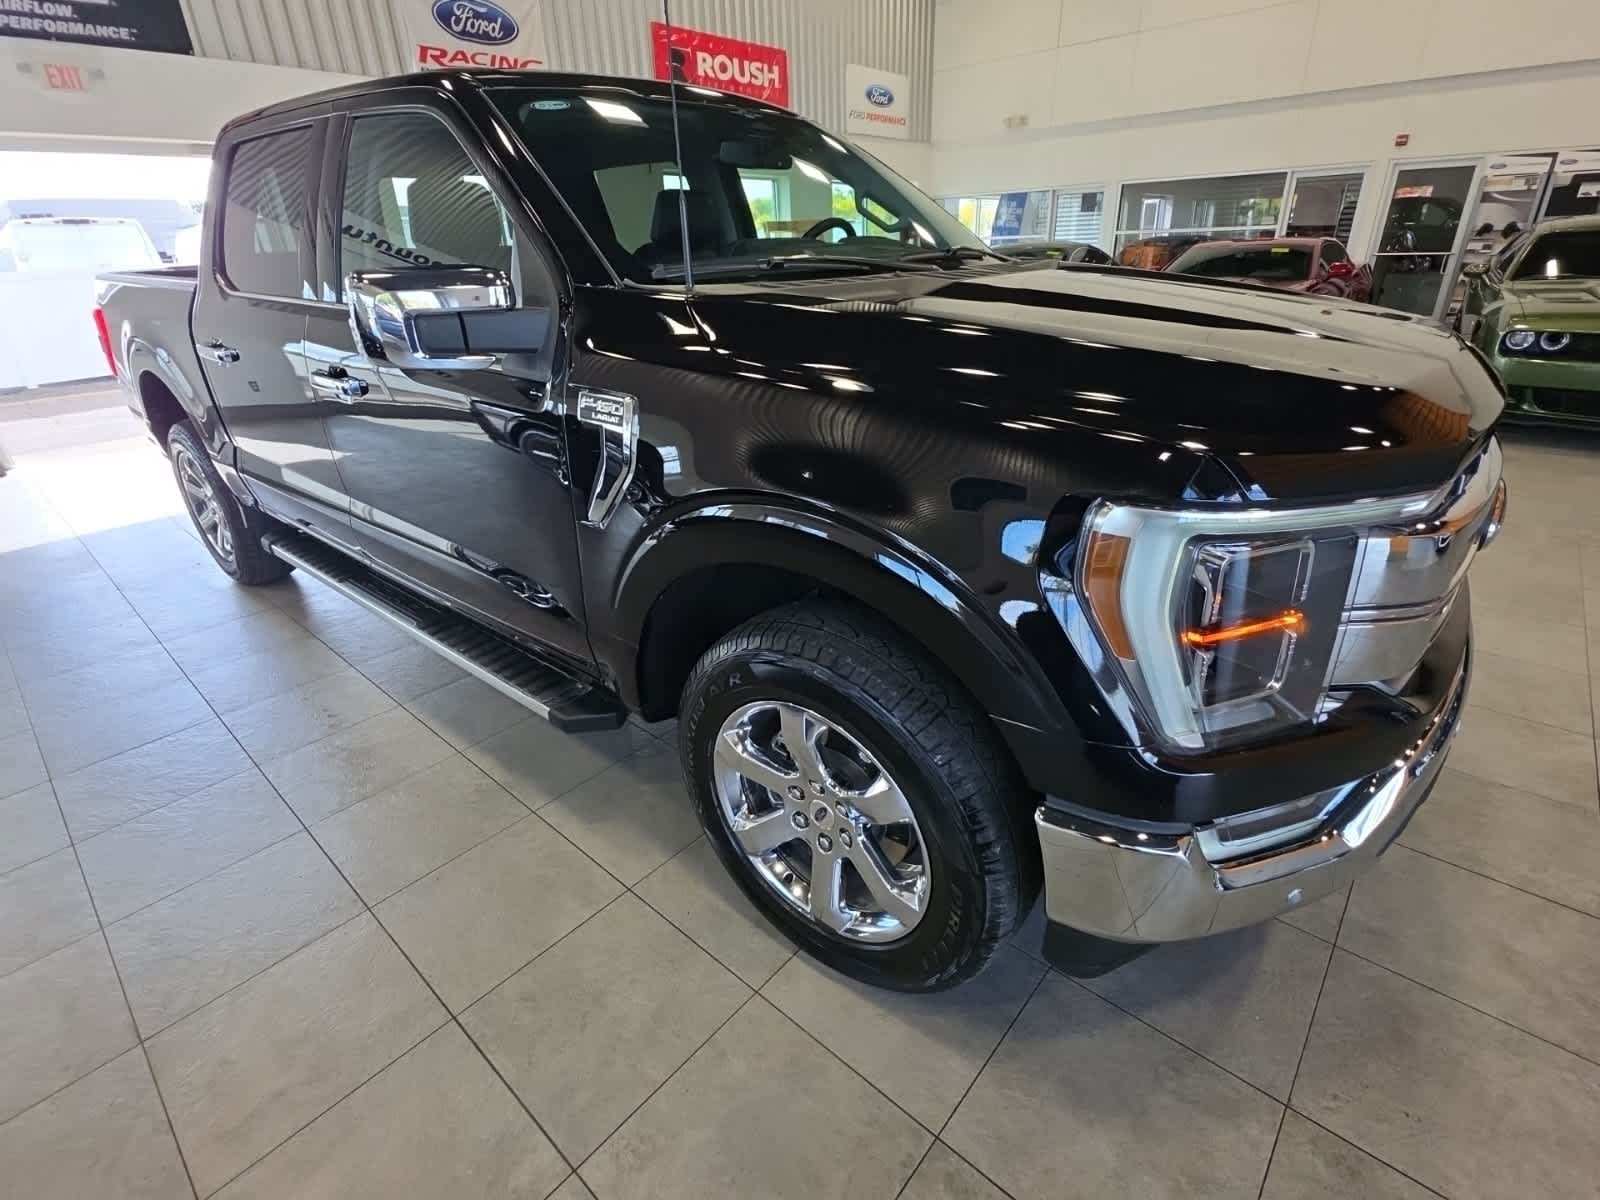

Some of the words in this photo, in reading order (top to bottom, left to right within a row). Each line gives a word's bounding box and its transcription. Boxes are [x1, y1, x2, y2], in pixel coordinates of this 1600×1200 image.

[451, 1, 505, 39] Ford
[696, 51, 781, 88] ROUSH
[871, 87, 889, 104] Ford
[591, 411, 621, 423] LARIAT
